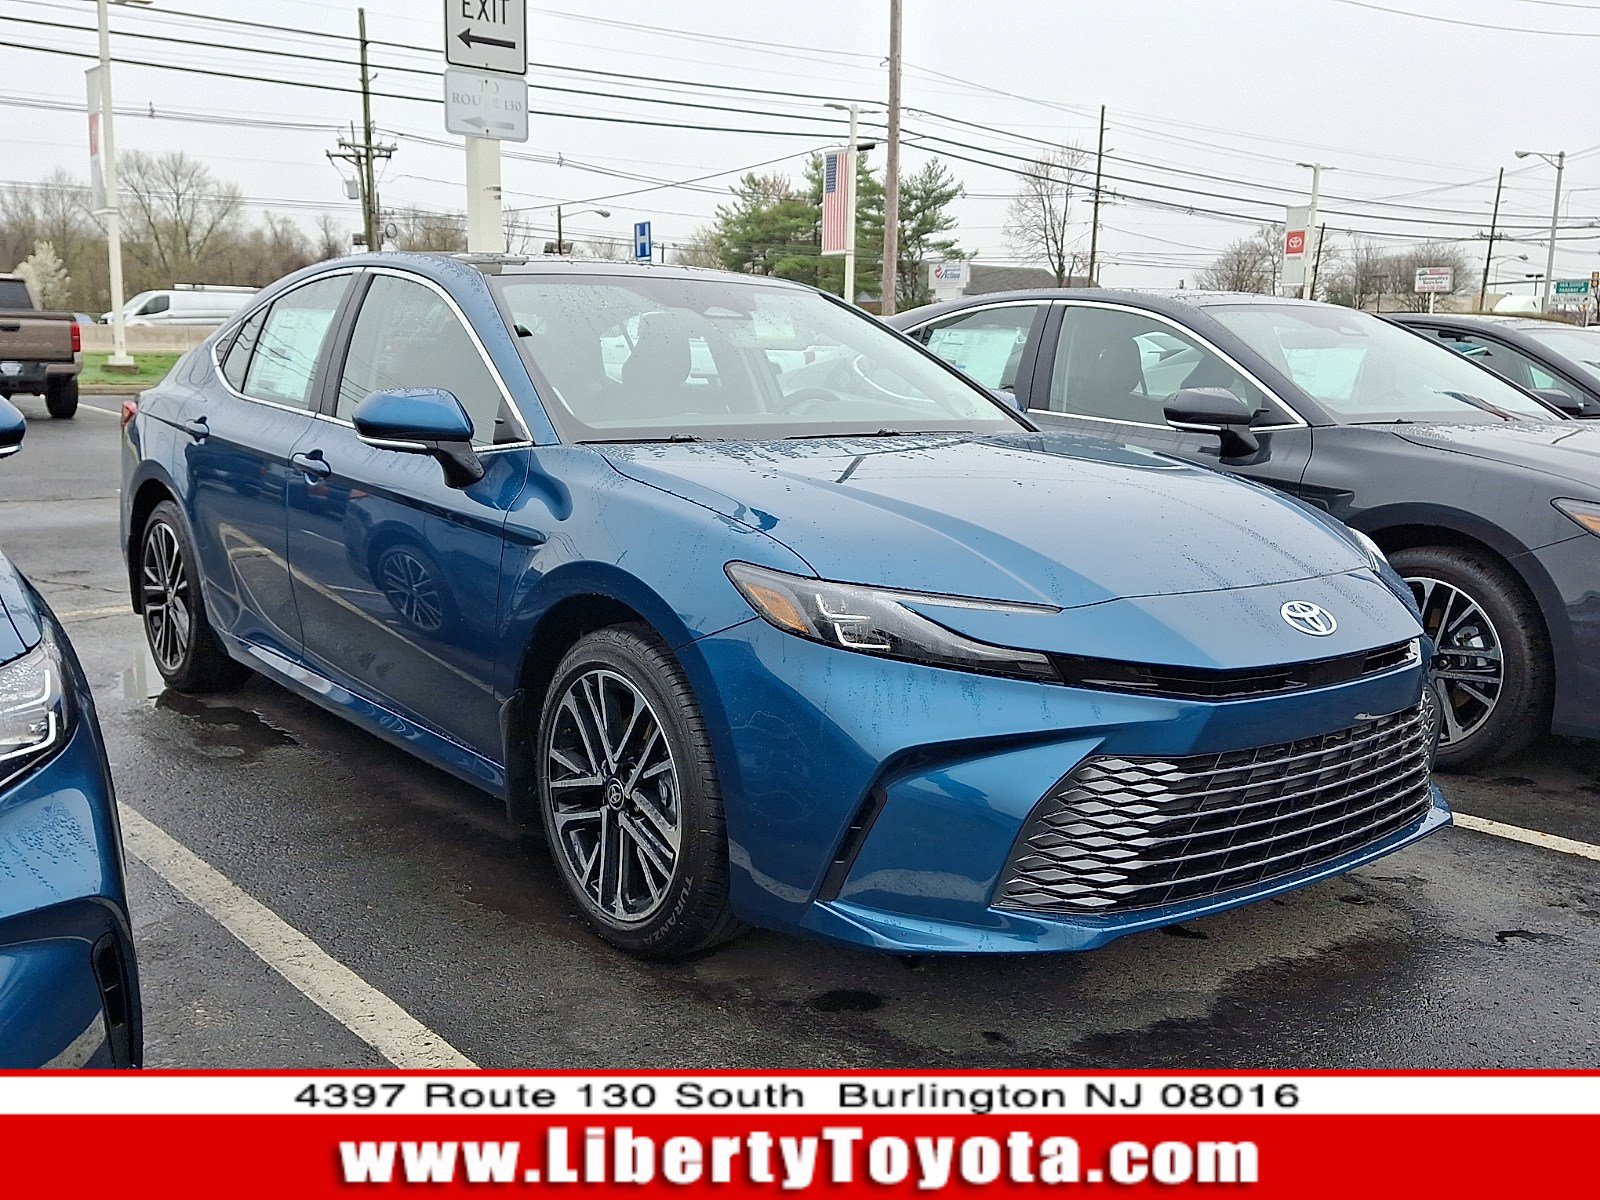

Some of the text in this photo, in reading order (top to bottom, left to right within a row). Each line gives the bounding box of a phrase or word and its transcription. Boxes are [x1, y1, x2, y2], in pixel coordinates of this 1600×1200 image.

[462, 0, 510, 25] EXIT
[451, 91, 522, 112] ROUE 130
[636, 223, 650, 256] H
[643, 876, 693, 945] TURANZA
